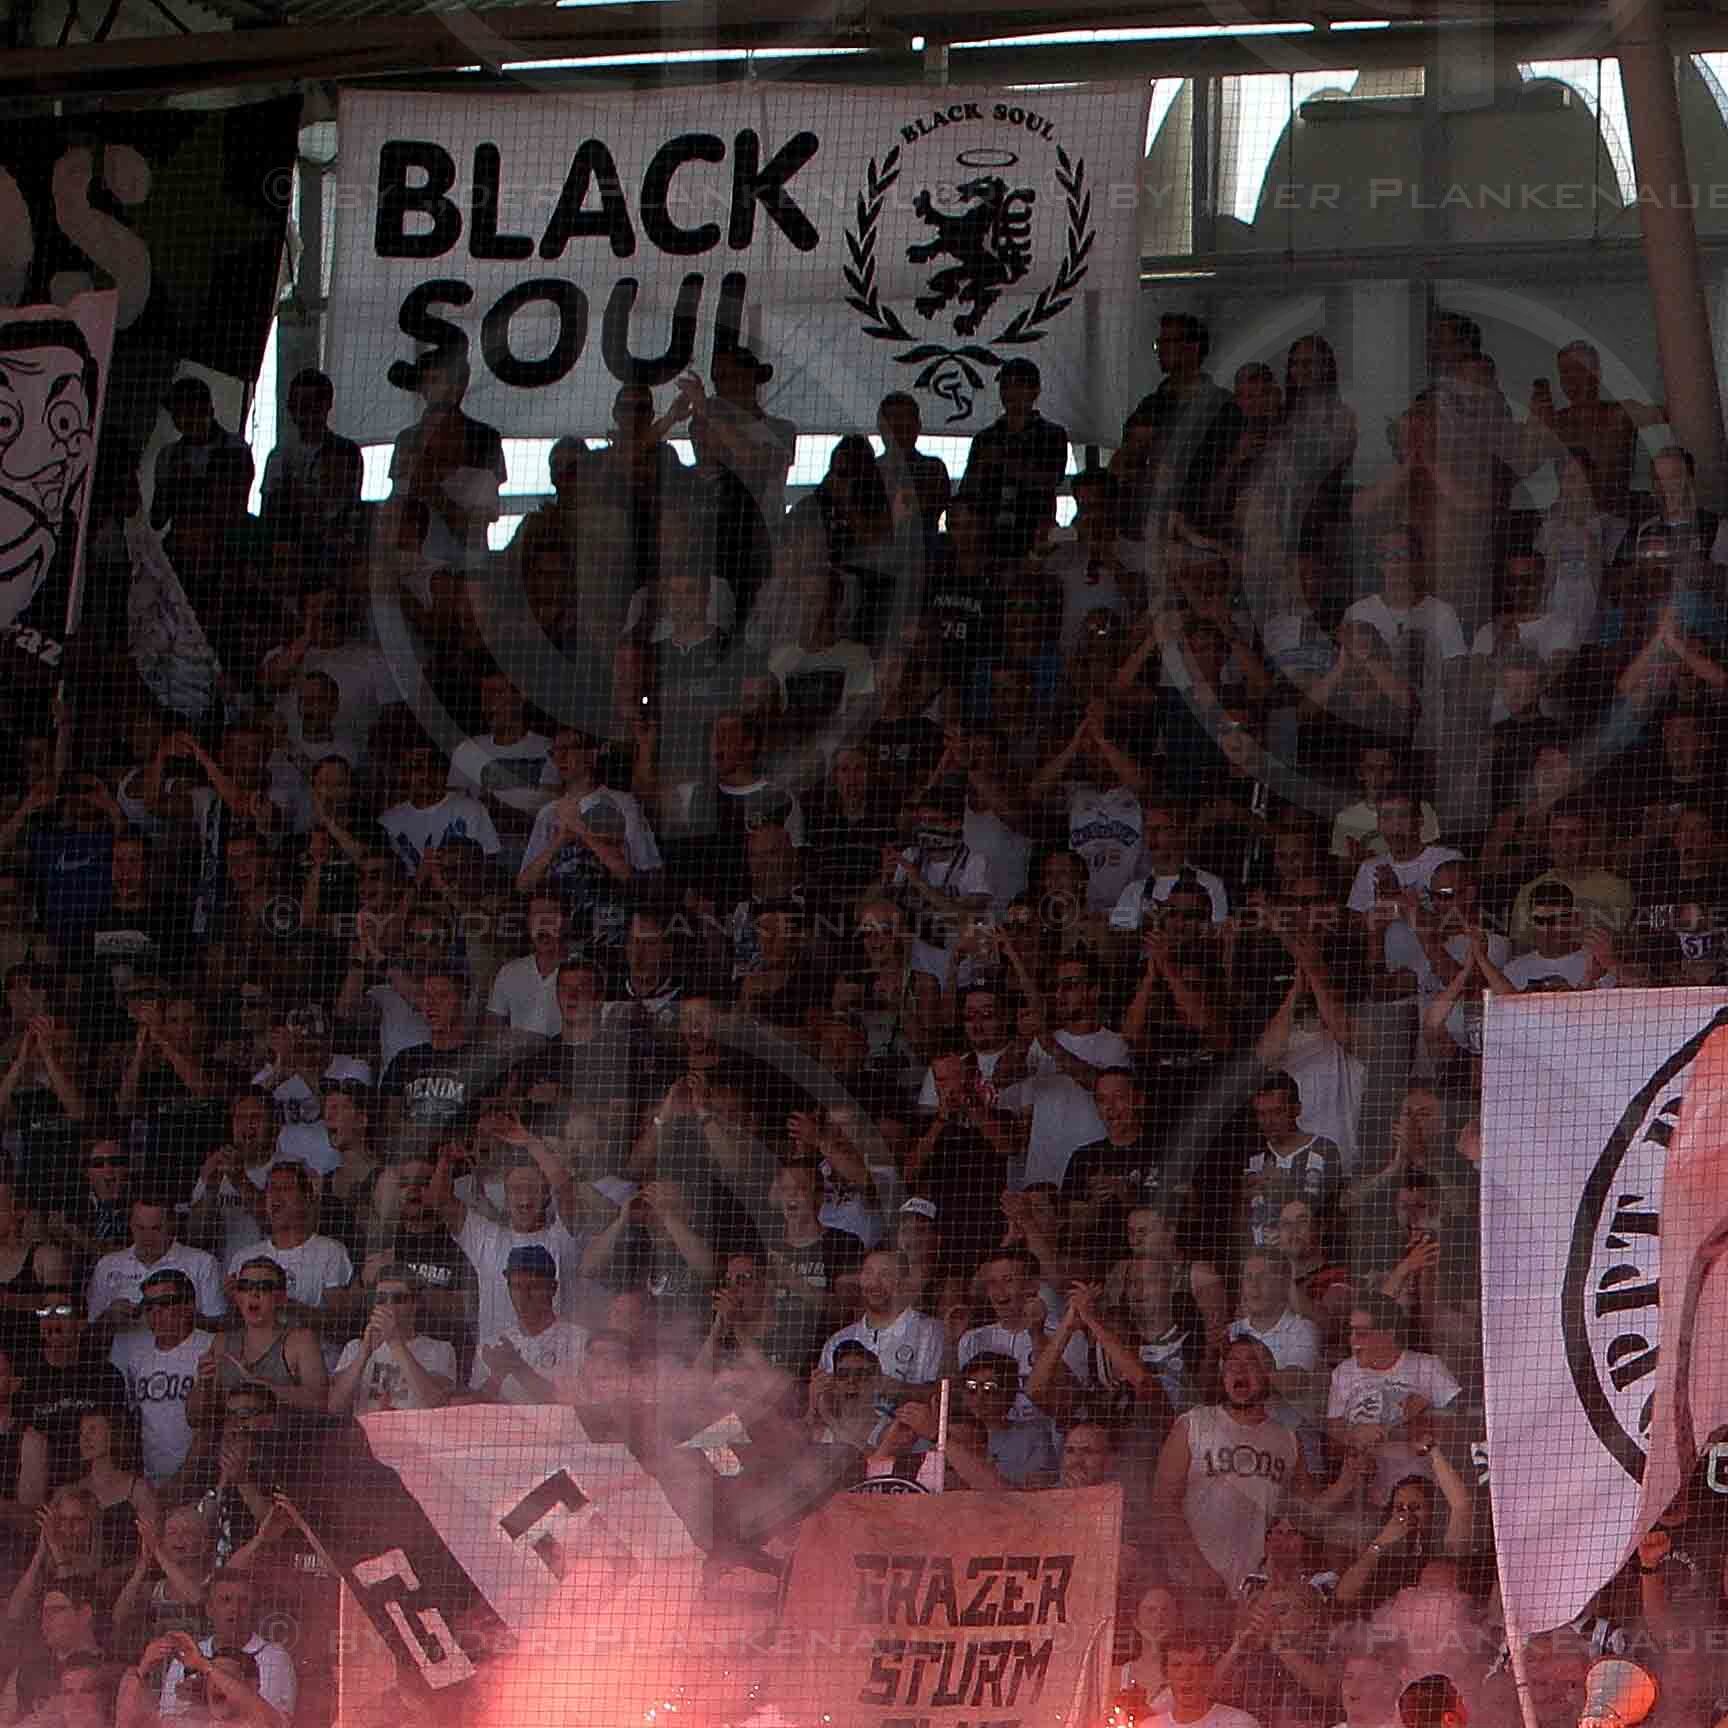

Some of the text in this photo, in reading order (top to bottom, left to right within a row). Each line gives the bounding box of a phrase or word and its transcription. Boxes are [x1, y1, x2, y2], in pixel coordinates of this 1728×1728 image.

[900, 103, 1055, 145] BLACK SOUL
[374, 129, 820, 259] BLACK
[389, 269, 774, 392] SOUL
[852, 1553, 1075, 1629] GRAZER
[857, 1637, 1055, 1708] STURM
